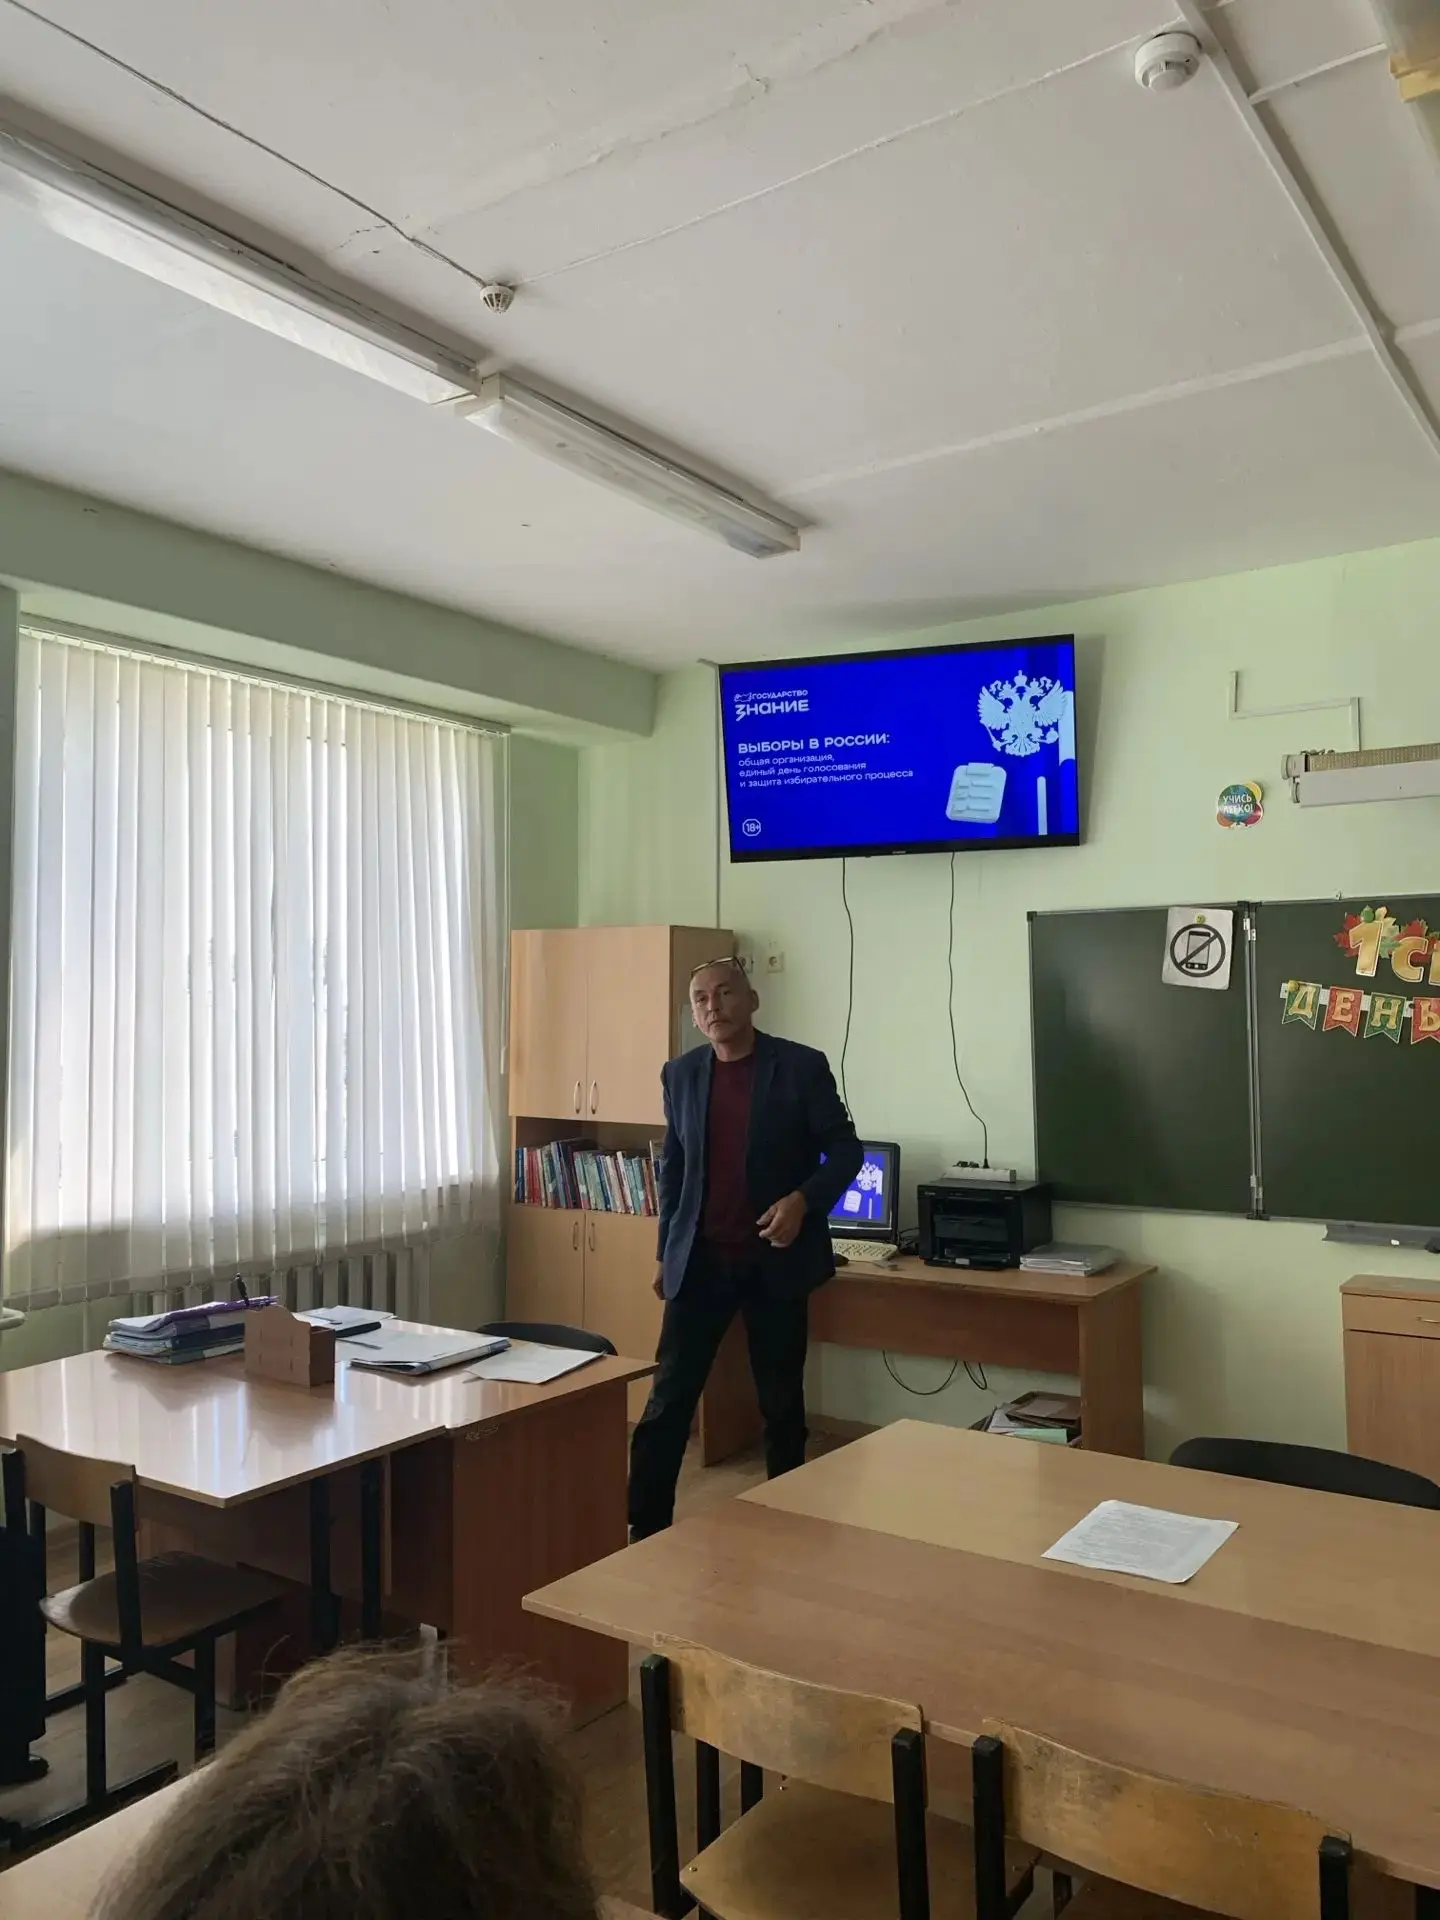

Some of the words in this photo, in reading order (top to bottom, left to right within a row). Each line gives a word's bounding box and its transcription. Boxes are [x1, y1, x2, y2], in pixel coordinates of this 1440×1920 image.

[738, 739, 804, 754] ВЫБОРЫ
[809, 738, 820, 749] В
[824, 732, 891, 748] РОССИИ:
[738, 757, 771, 767] общая
[772, 754, 835, 765] организация,
[739, 767, 776, 777] единый
[777, 766, 801, 775] день
[803, 762, 867, 773] голосования
[739, 780, 746, 788] и
[748, 776, 782, 787] защита
[783, 772, 863, 785] избирательного
[864, 769, 914, 781] процесса
[1223, 793, 1252, 804] УЧИСЬ
[1223, 803, 1254, 814] ЛЕГКО!
[745, 823, 760, 832] 18+
